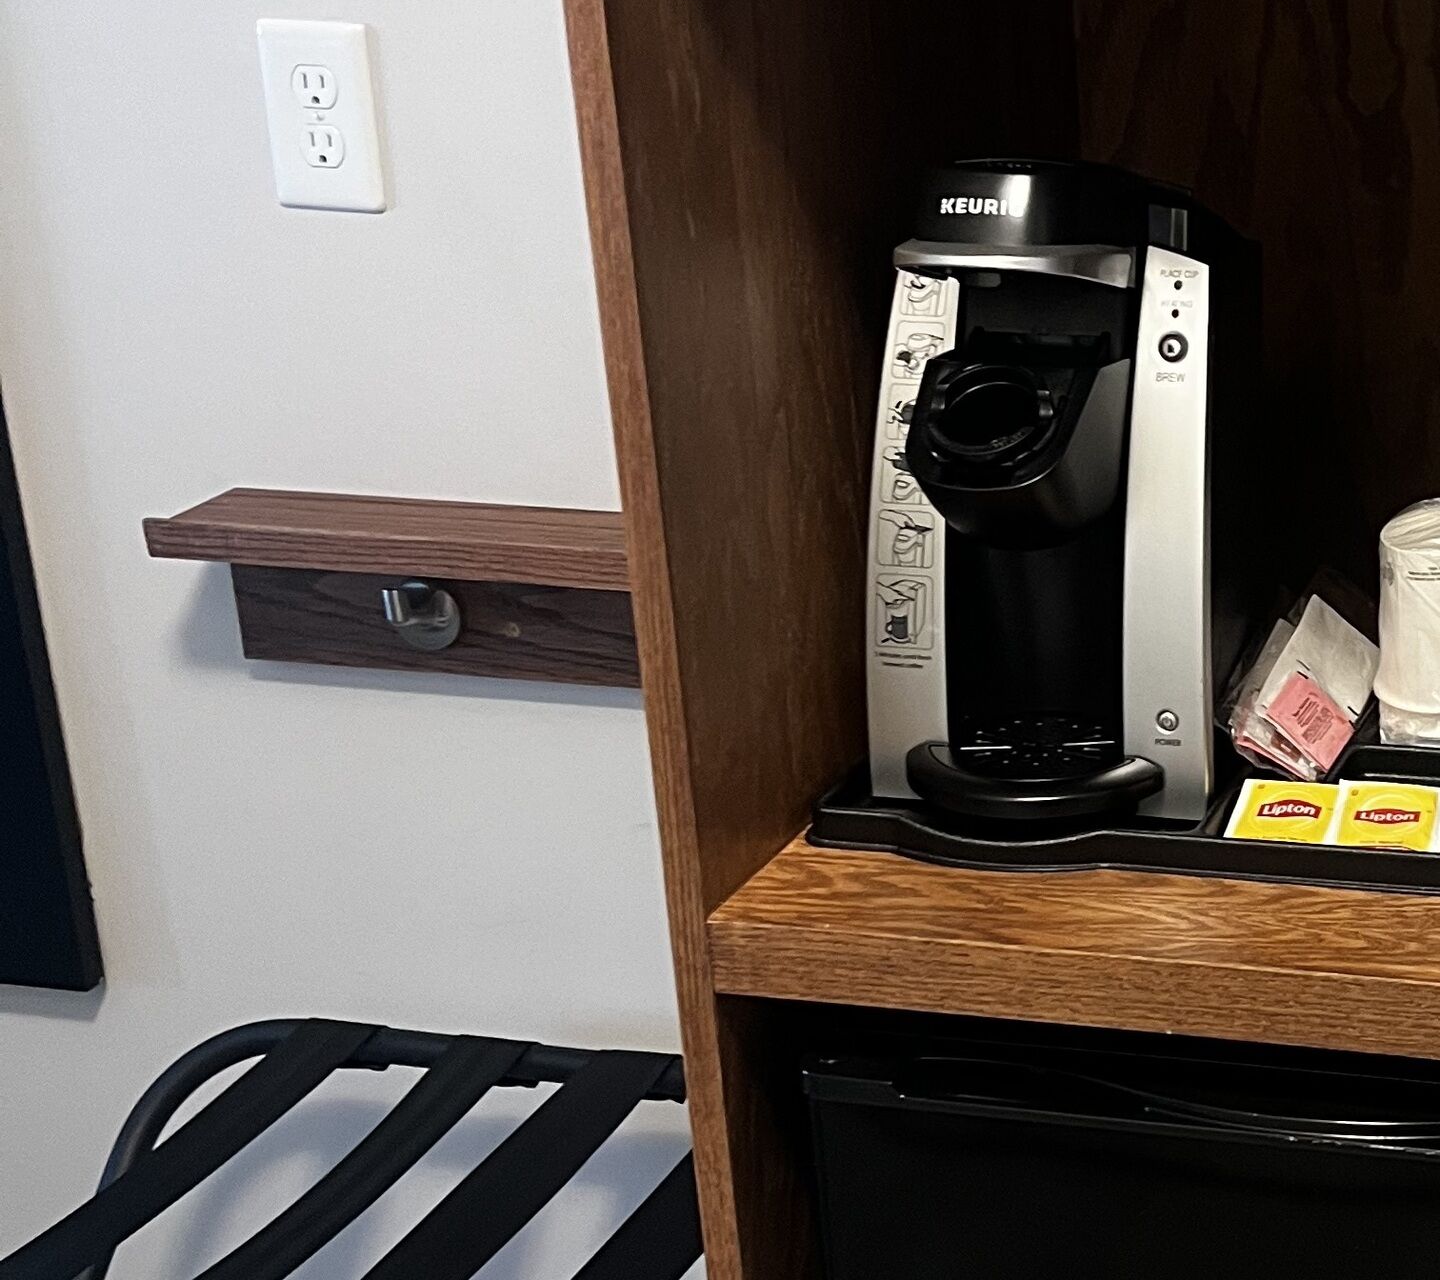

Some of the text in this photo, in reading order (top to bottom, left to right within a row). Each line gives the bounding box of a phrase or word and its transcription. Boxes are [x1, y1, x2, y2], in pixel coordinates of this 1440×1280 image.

[940, 197, 1025, 217] KEURI
[1155, 372, 1185, 382] BREW
[1262, 805, 1316, 816] Lipton
[1360, 811, 1414, 821] Lipton
